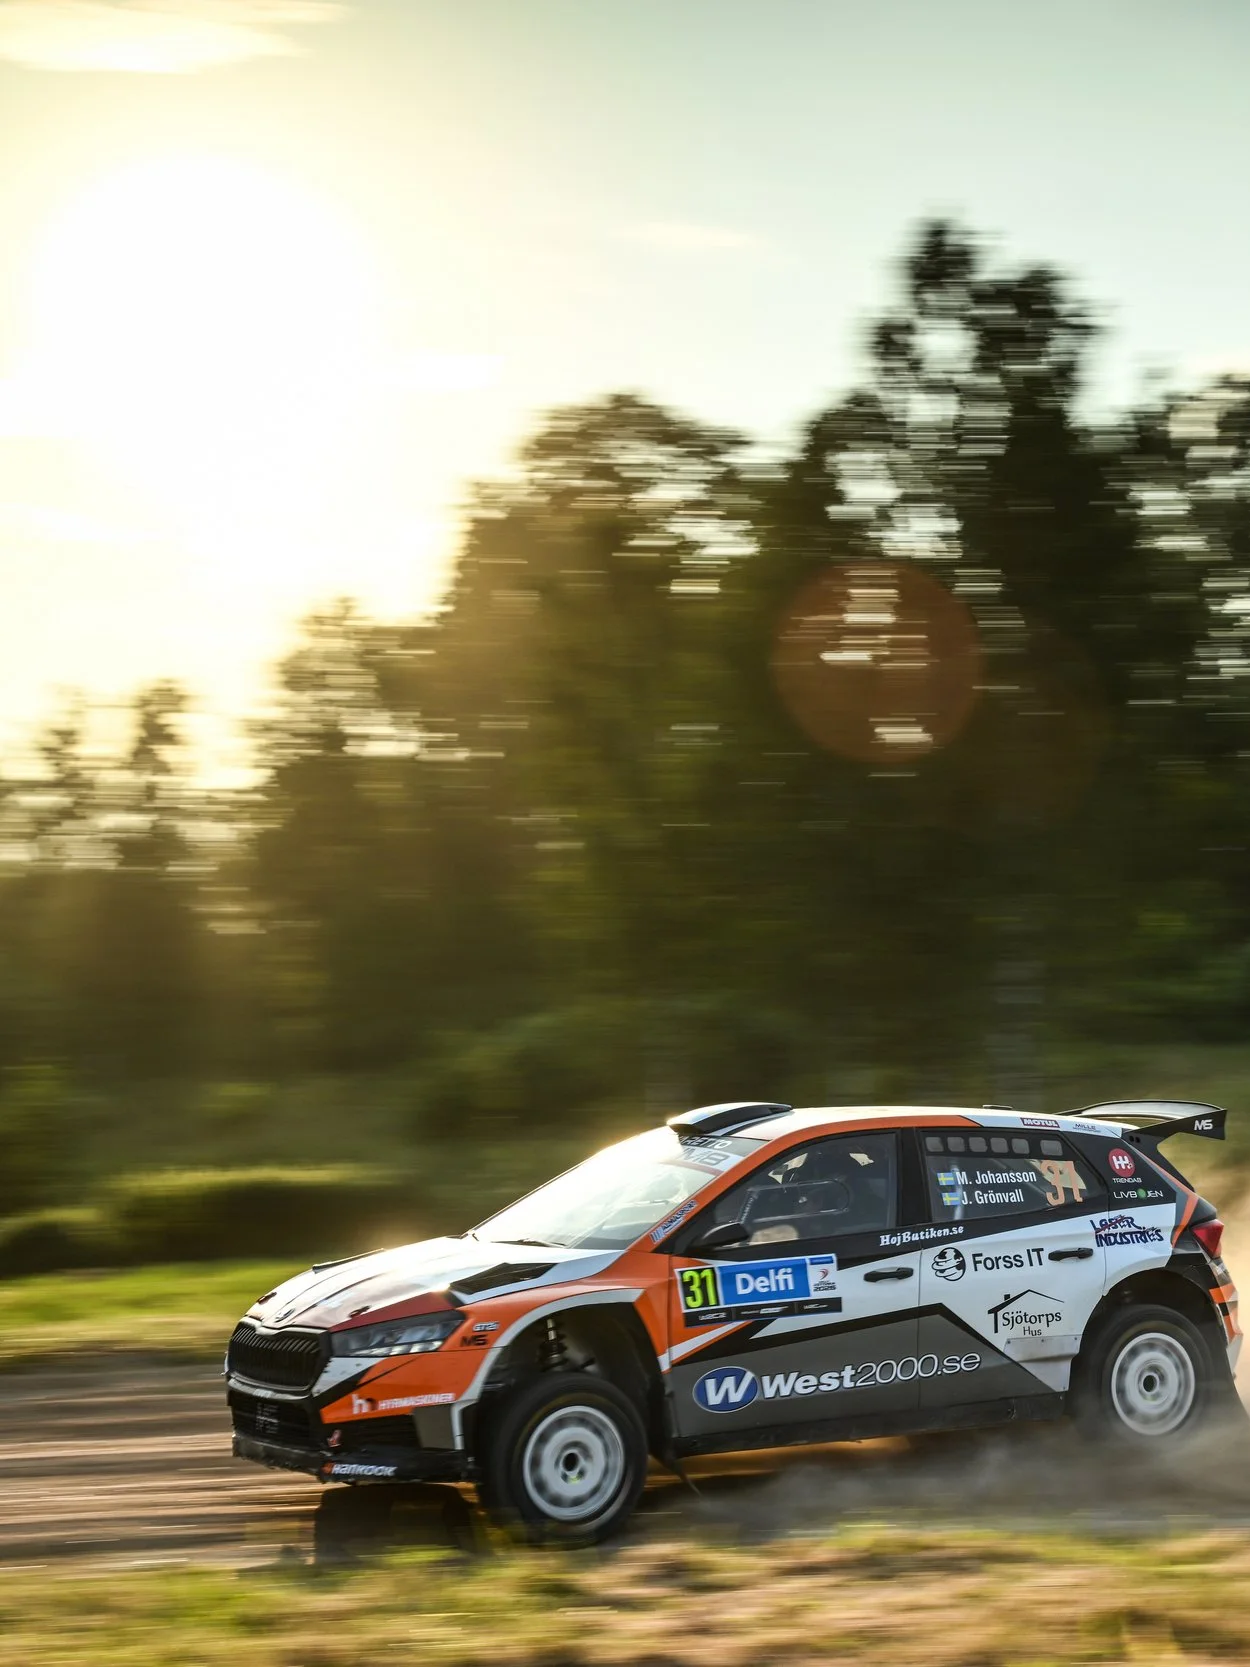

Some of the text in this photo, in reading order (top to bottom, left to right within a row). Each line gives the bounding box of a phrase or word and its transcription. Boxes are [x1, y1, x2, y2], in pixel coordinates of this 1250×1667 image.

[1023, 1118, 1059, 1127] MOTUL
[956, 1170, 1037, 1185] M. Johansson
[961, 1188, 1024, 1205] J. Grönvall
[1095, 1227, 1164, 1247] INDUSTRIES
[971, 1248, 1044, 1272] Forss IT
[681, 1268, 718, 1308] 31
[735, 1267, 795, 1295] Delfi
[1002, 1310, 1062, 1330] Sjötorps
[1023, 1326, 1042, 1337] Hus
[704, 1352, 981, 1406] W West2000.se
